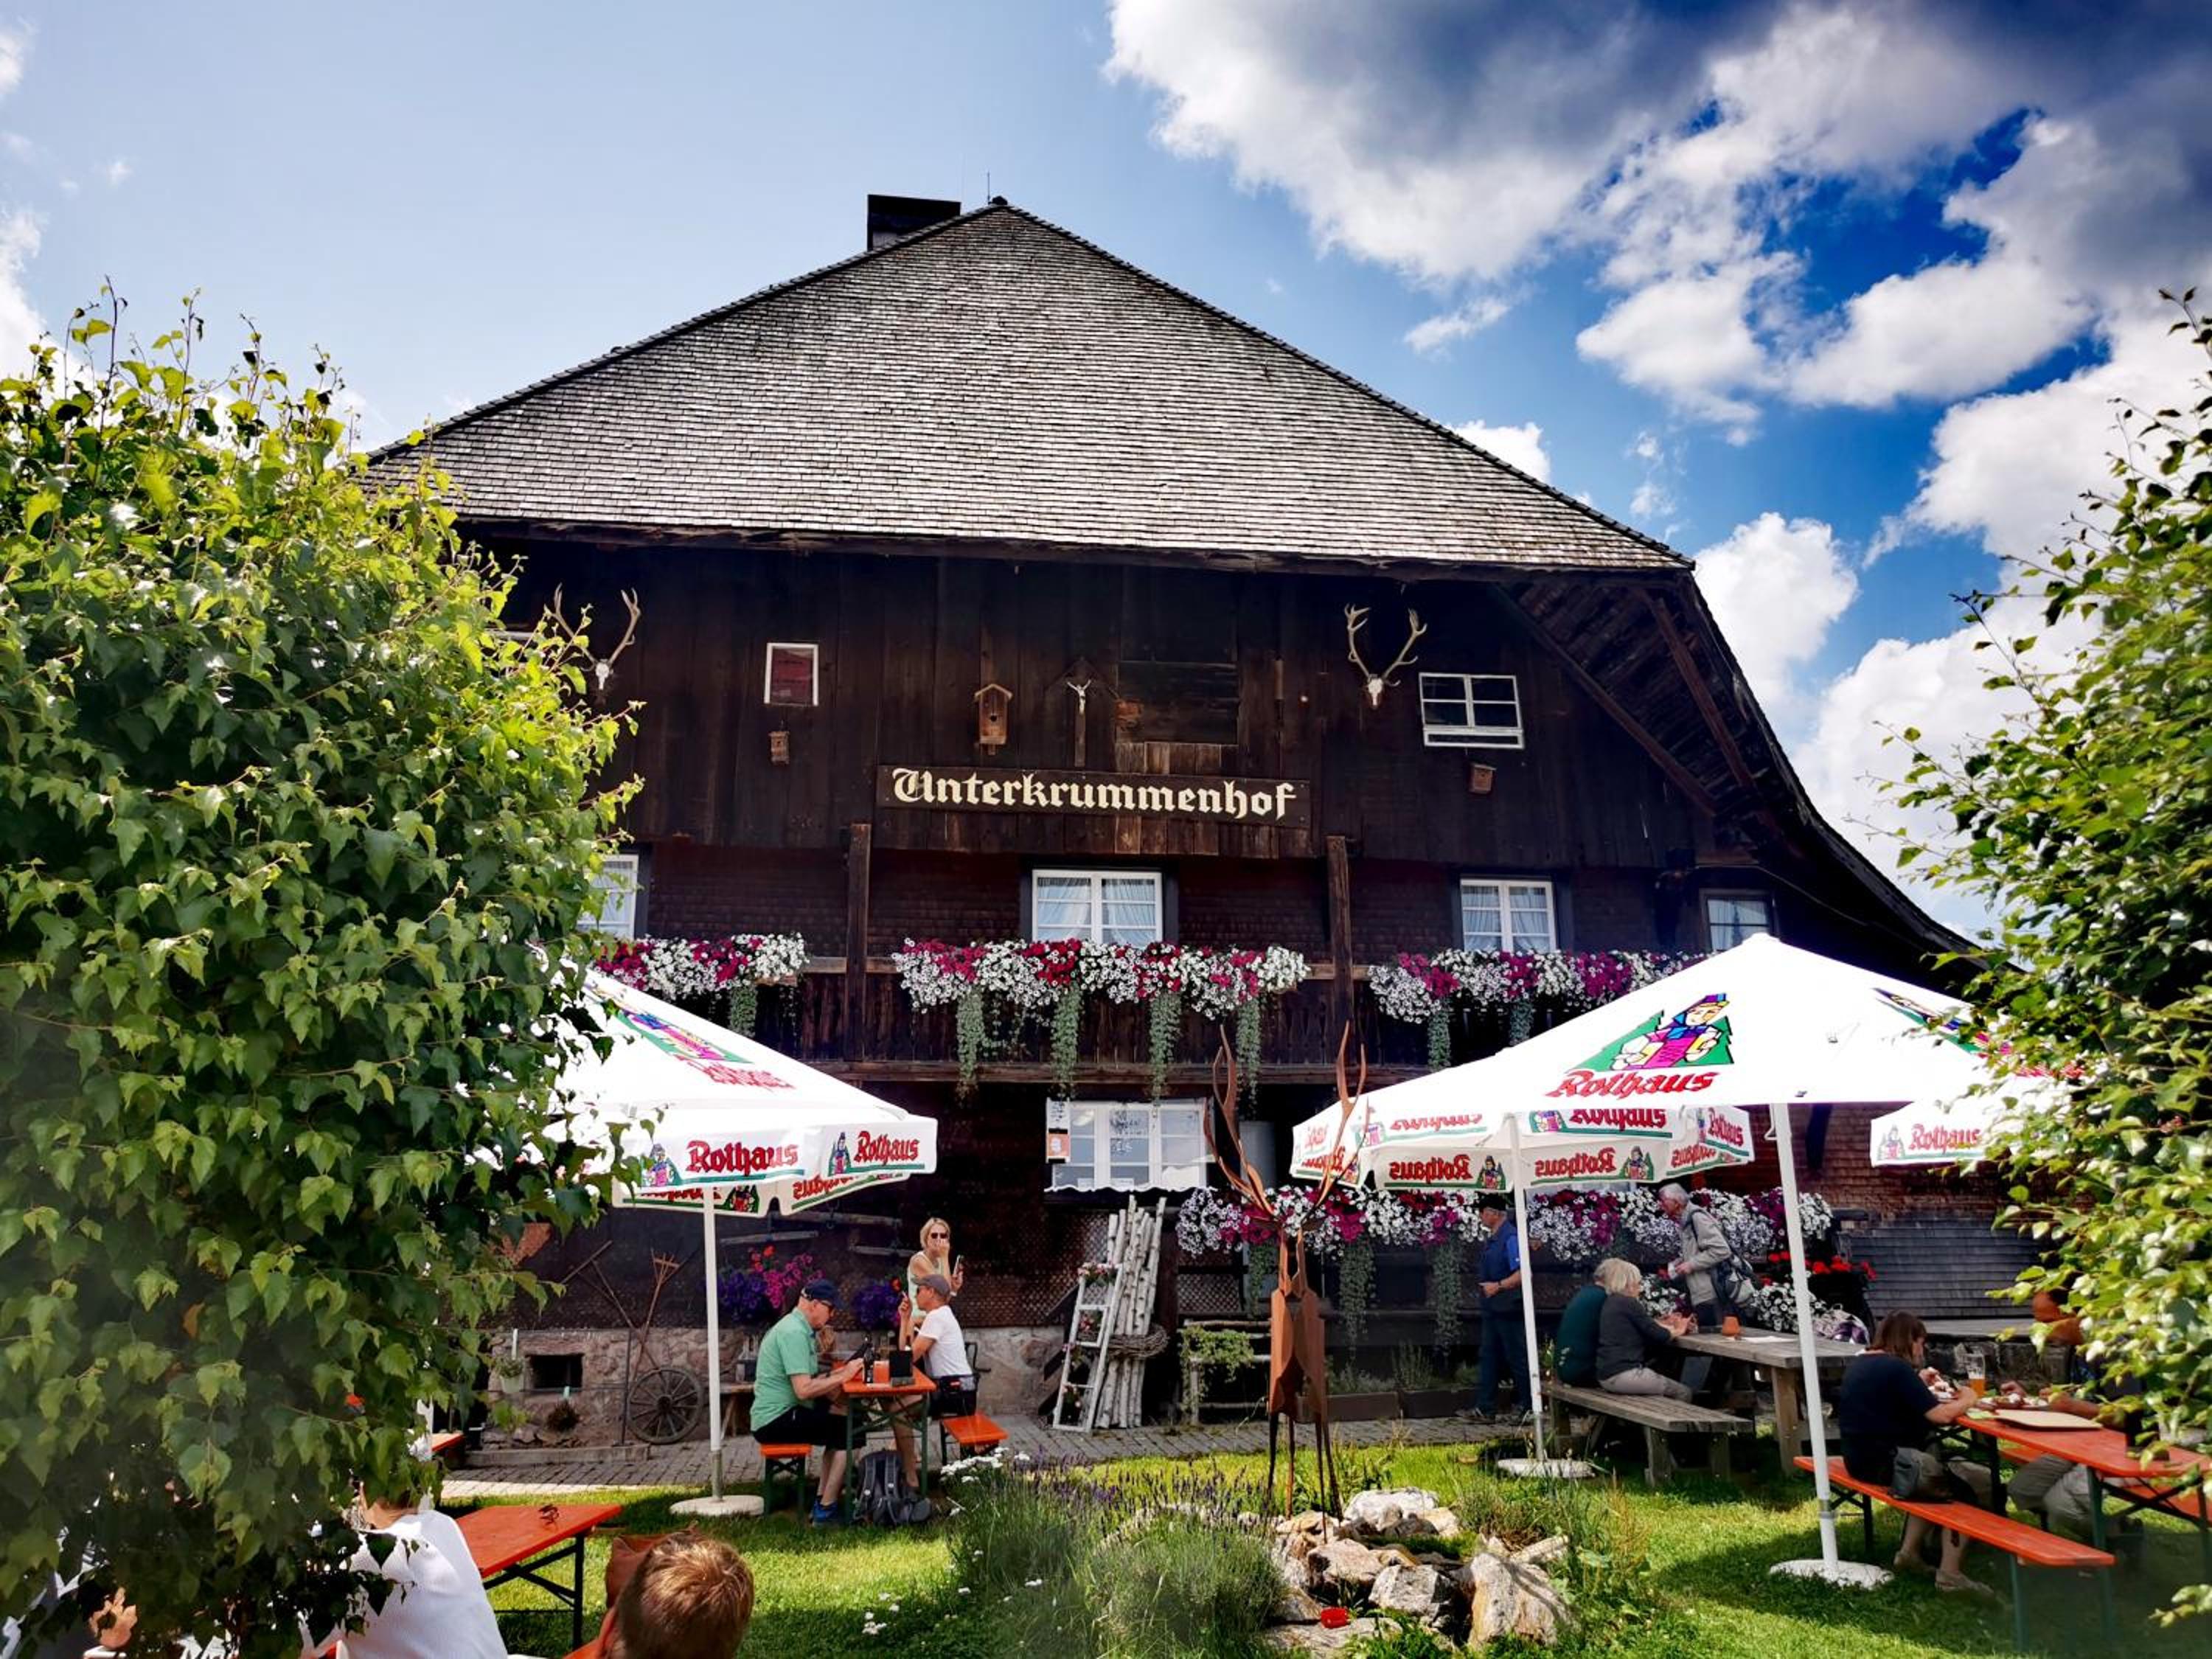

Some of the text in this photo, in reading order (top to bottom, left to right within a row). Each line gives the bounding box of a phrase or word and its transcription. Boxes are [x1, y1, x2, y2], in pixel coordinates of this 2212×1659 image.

[892, 768, 1295, 820] Unterkrummenhof
[1545, 1071, 1719, 1099] Rothaus
[686, 1140, 799, 1176] Rothaus
[854, 1131, 919, 1165] Rothaus
